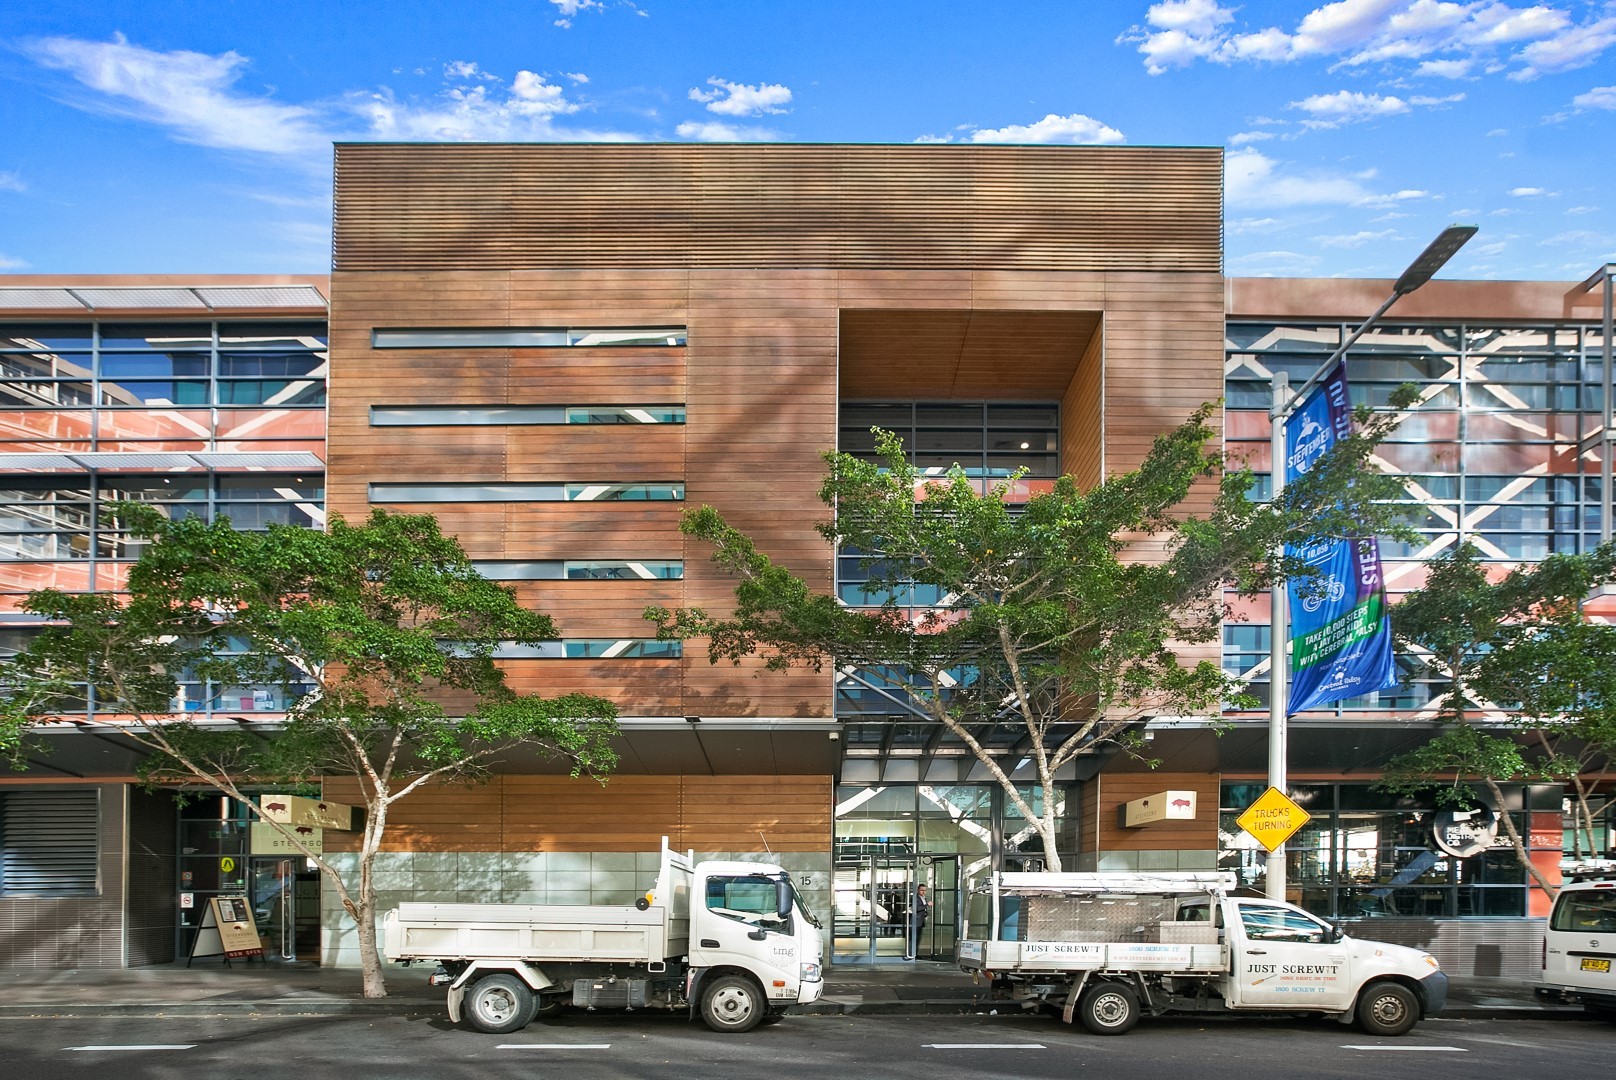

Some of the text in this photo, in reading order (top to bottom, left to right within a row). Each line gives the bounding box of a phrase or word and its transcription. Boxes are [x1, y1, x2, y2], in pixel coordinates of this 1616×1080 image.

[1287, 426, 1331, 469] STEPTEMBER
[1305, 631, 1323, 645] TAKE
[1346, 605, 1368, 624] STEPS
[1332, 628, 1346, 642] FOR
[1346, 617, 1364, 634] KIDS
[1320, 632, 1354, 658] CEREBRAL
[1255, 807, 1290, 819] TRUCKS
[1253, 819, 1292, 831] TURNING
[800, 876, 811, 886] 15
[1025, 944, 1050, 953] JUST
[1247, 964, 1277, 974] JUST
